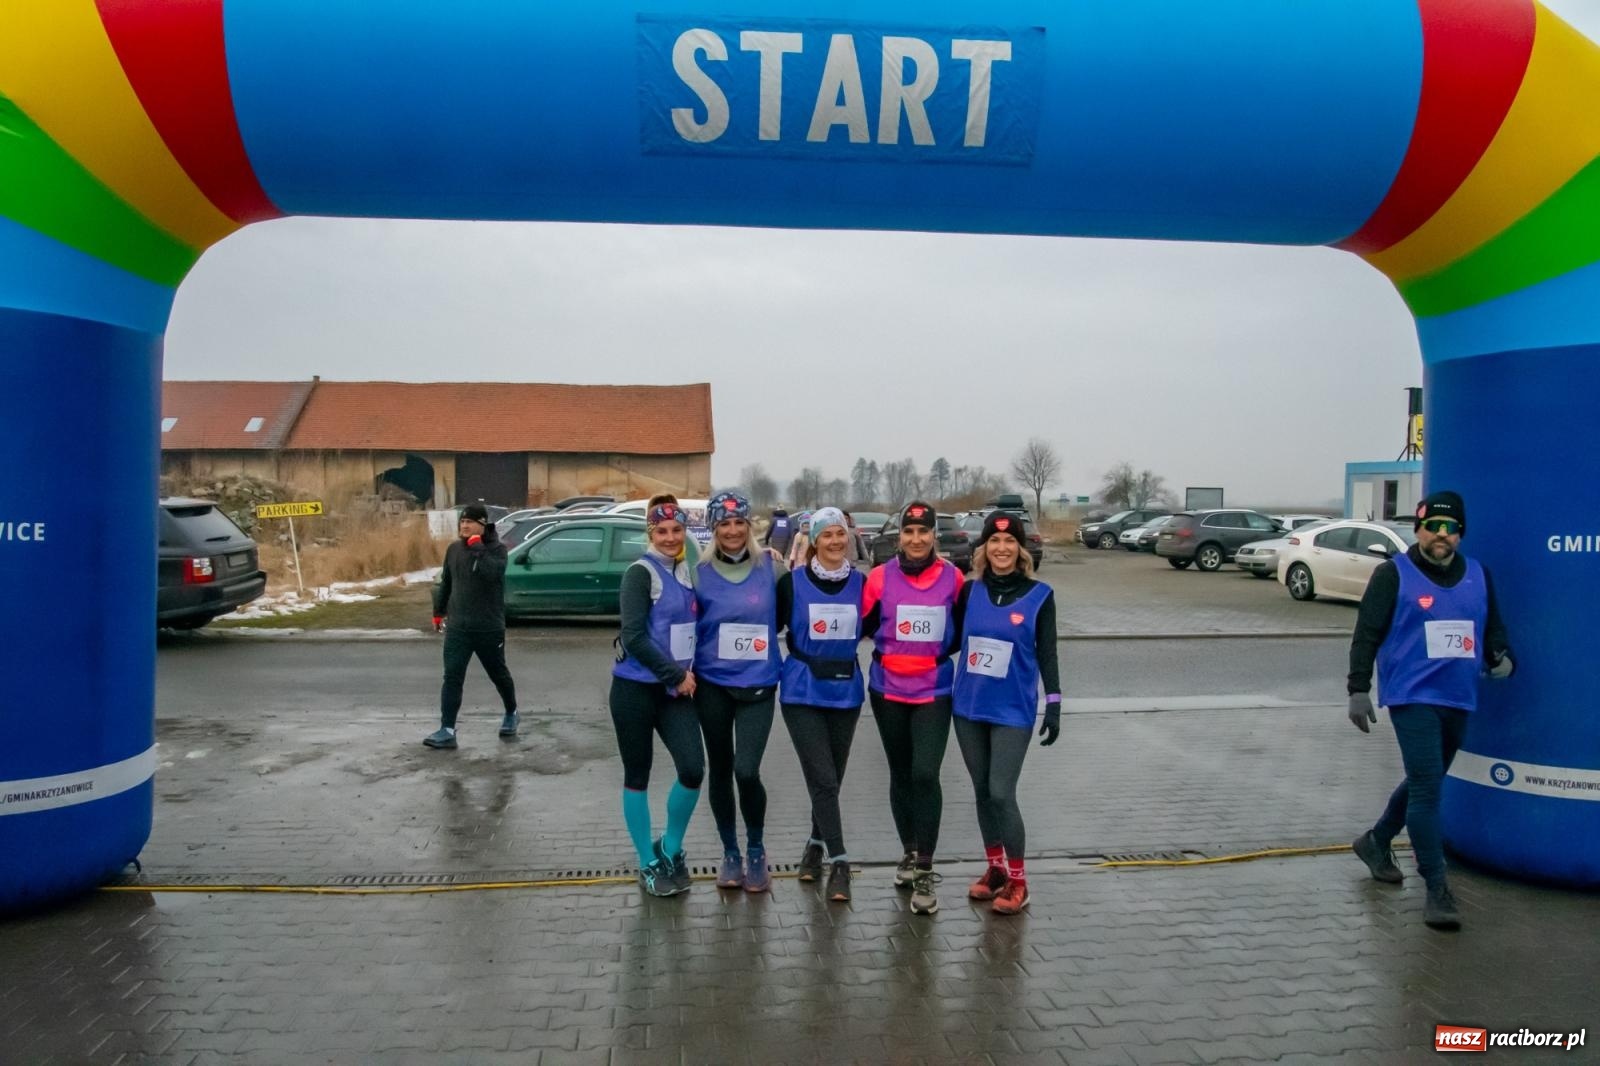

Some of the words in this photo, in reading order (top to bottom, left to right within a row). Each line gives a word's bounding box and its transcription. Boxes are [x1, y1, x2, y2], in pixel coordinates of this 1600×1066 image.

[671, 28, 1012, 147] START
[257, 504, 308, 516] PARKING
[0, 522, 45, 541] ICE
[830, 618, 839, 632] 4
[912, 620, 931, 634] 68
[734, 637, 753, 651] 67
[1444, 634, 1463, 649] 73
[976, 652, 993, 668] 72
